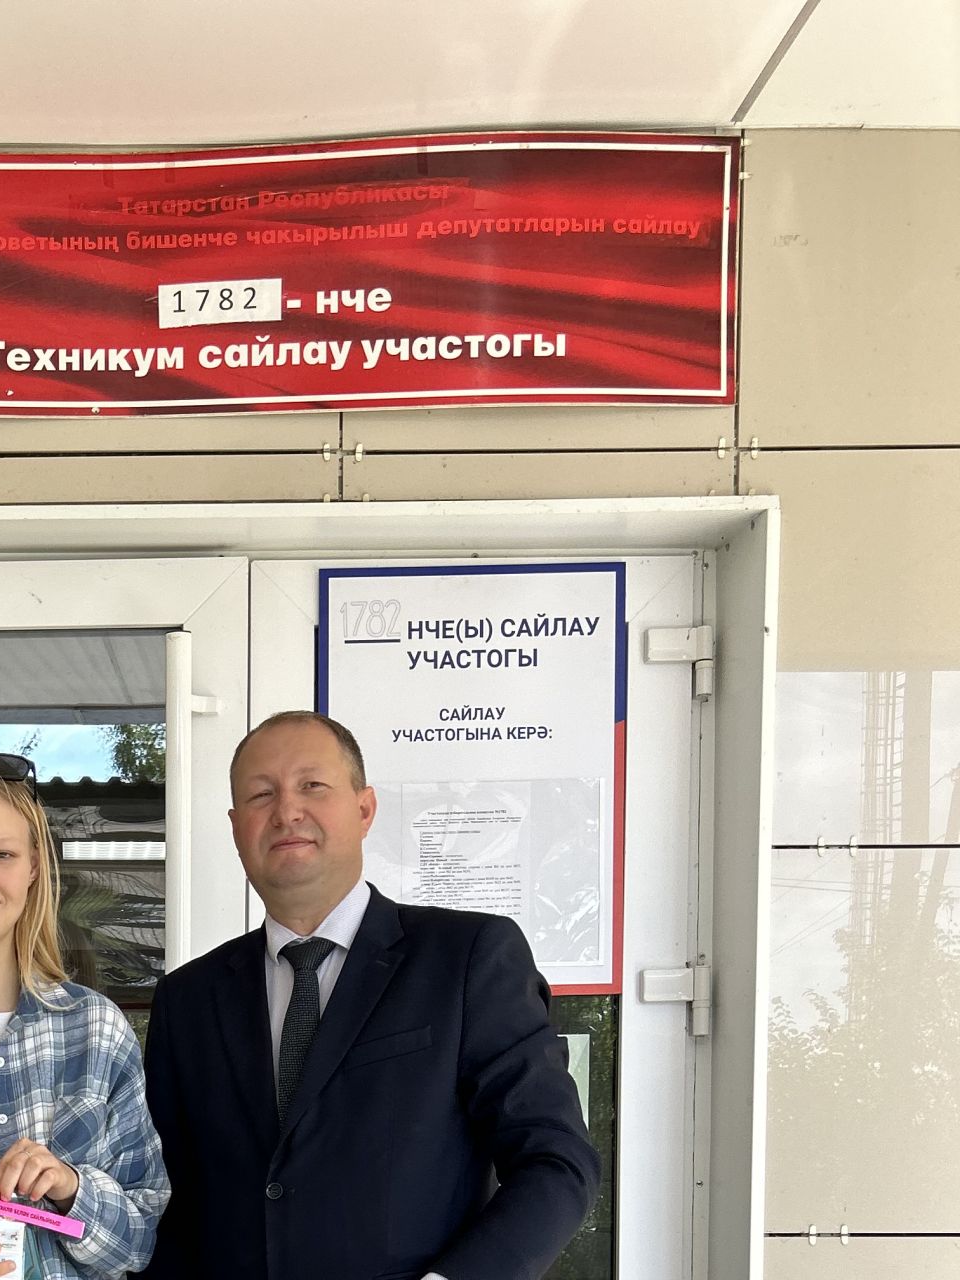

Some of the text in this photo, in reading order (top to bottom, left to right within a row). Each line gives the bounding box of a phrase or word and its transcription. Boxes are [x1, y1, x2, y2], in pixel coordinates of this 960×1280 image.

[118, 184, 451, 218] Татарстан Республикасы
[126, 230, 238, 250] бишенче
[246, 221, 408, 246] чакырылыш
[416, 217, 606, 240] депутатларын
[612, 214, 701, 240] сайлау
[172, 286, 258, 314] 1782
[315, 287, 392, 315] нче
[198, 335, 352, 371] сайлау
[360, 333, 567, 370] участогы
[339, 598, 600, 644] 1782 НЧЕ(Ы) САЙЛАУ
[406, 647, 539, 670] УЧАСТОГЫ
[438, 705, 506, 722] САЙЛАУ
[391, 726, 553, 743] УЧАСТОГЫНА КЕРӘ:
